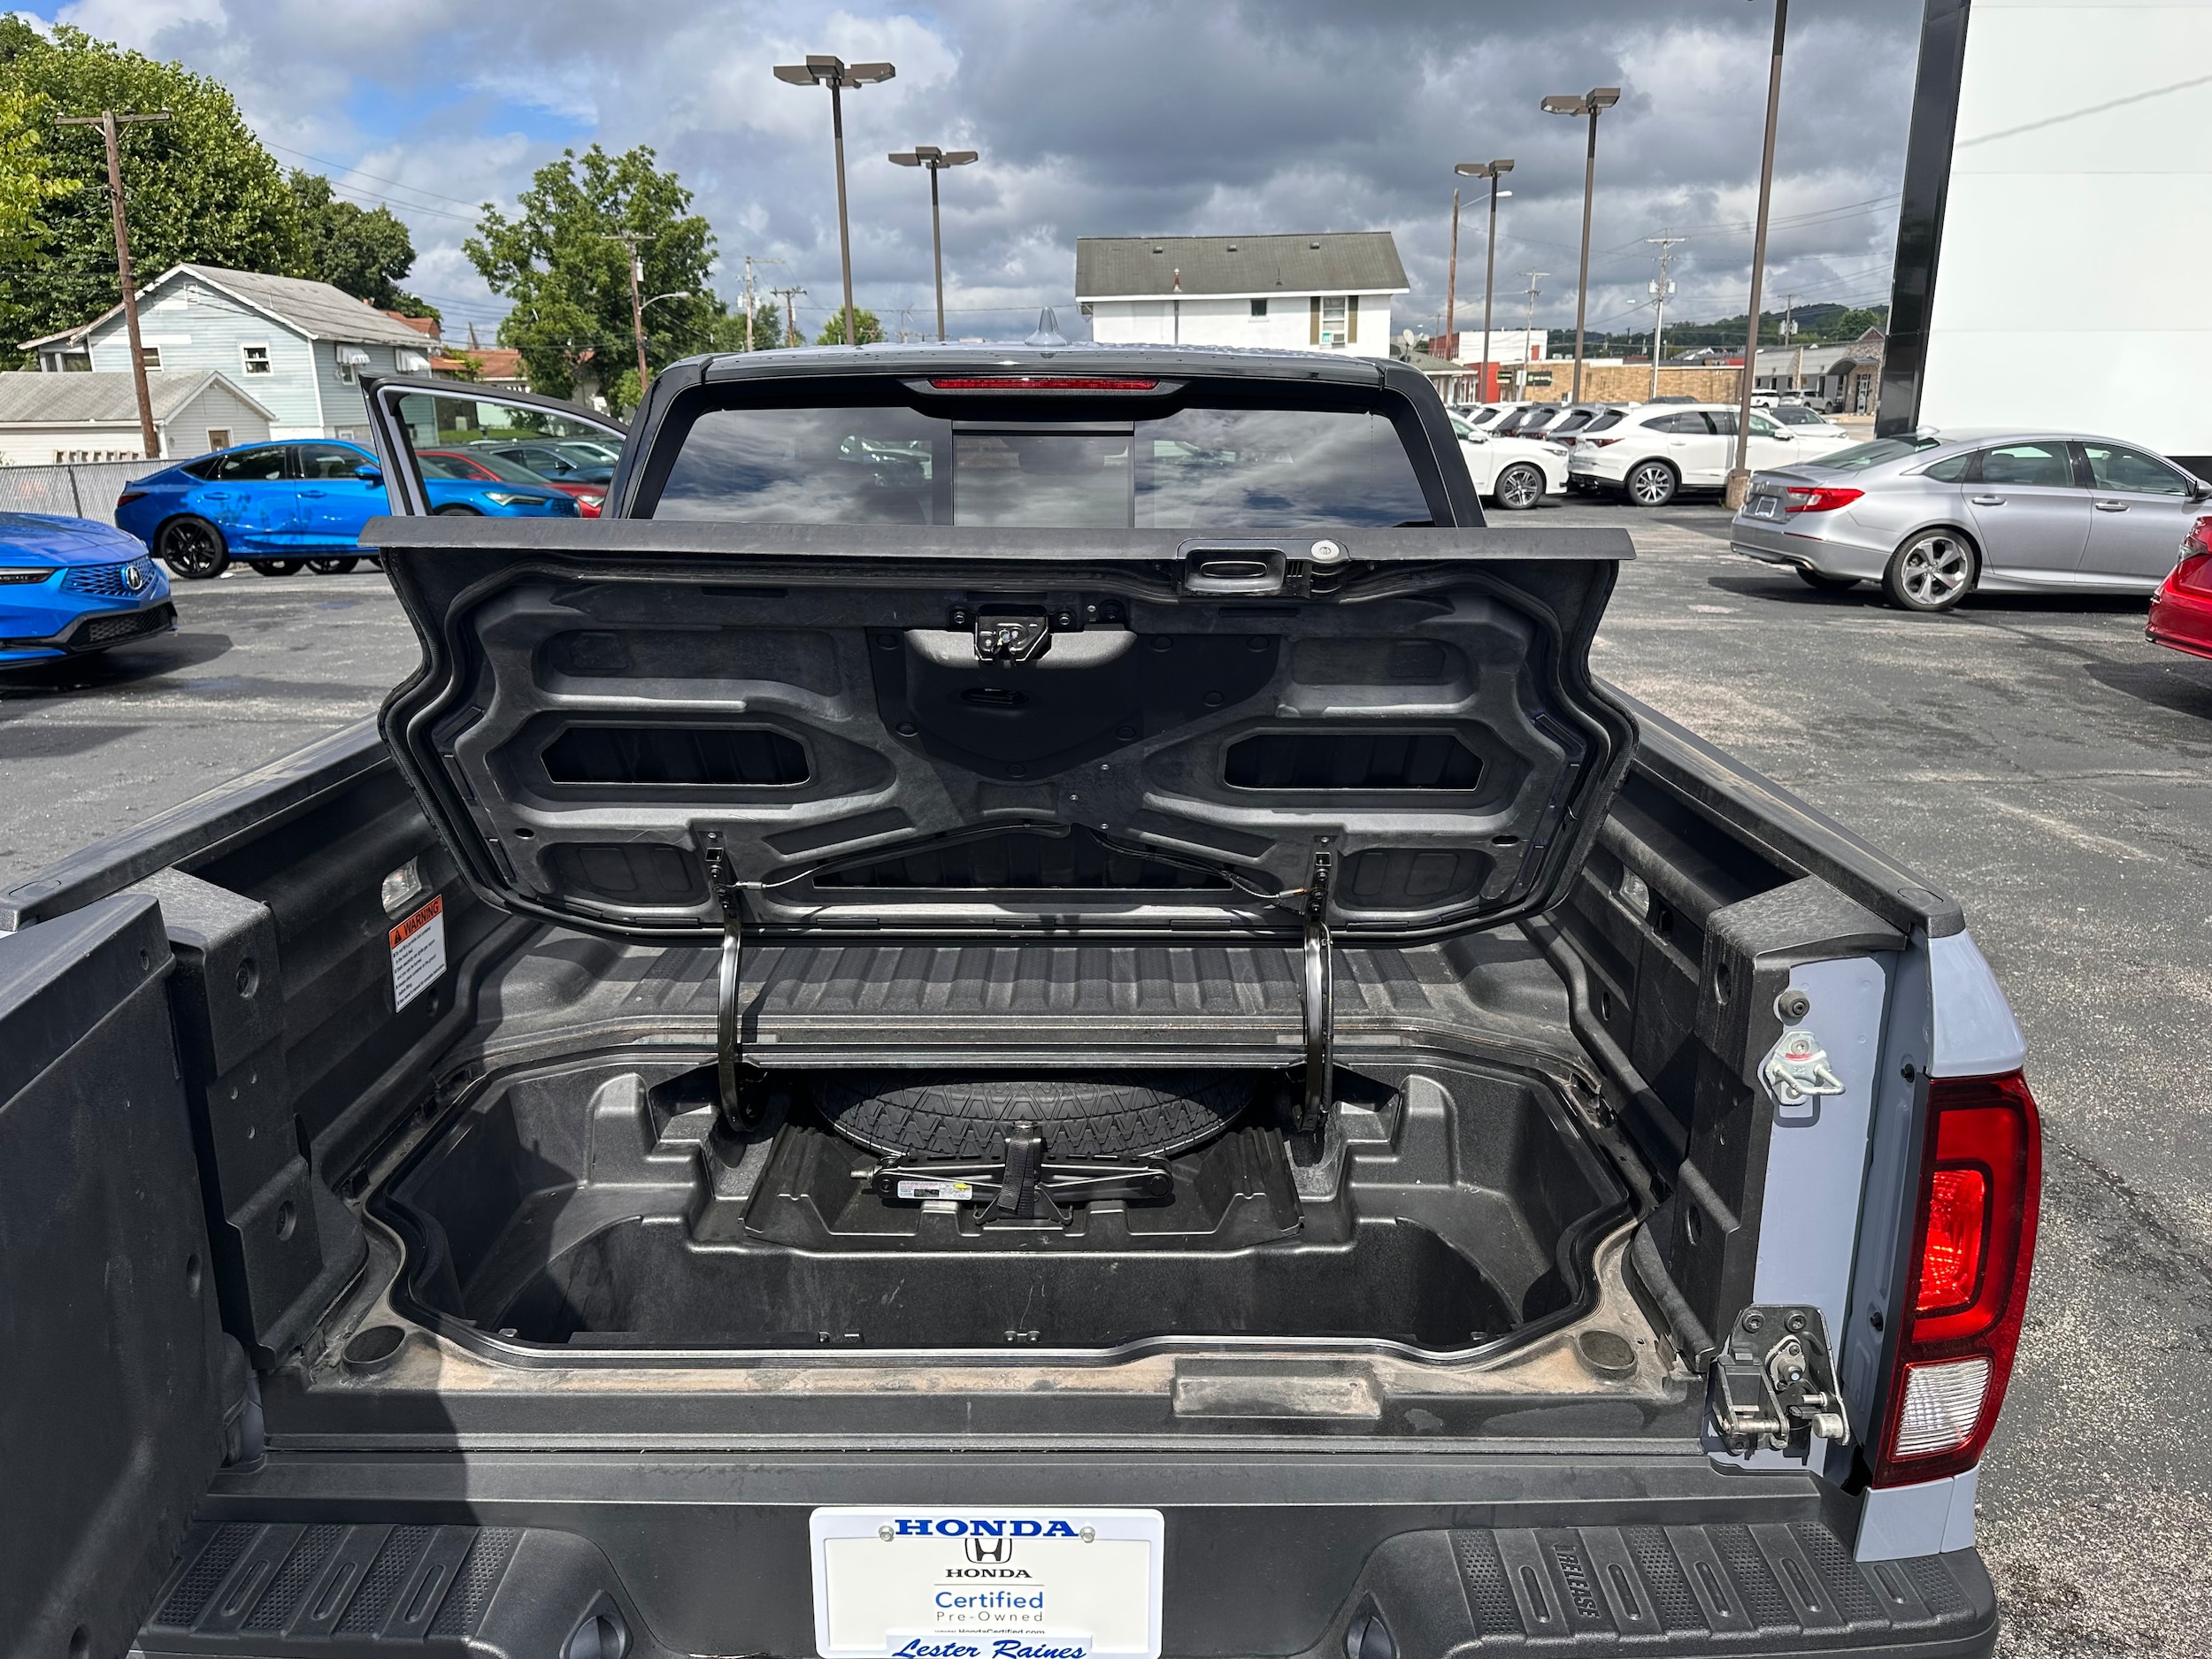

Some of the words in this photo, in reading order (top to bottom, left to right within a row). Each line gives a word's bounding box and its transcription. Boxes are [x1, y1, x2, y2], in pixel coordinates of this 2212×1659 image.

[403, 901, 440, 934] WARNING
[895, 1519, 1079, 1536] HONDA
[945, 1569, 1032, 1578] HONDA
[1556, 1553, 1601, 1618] RELEASE
[935, 1591, 1043, 1609] Certified
[936, 1611, 1043, 1622] Pre-Owned
[892, 1638, 981, 1659] Lester
[992, 1640, 1087, 1659] Raines
